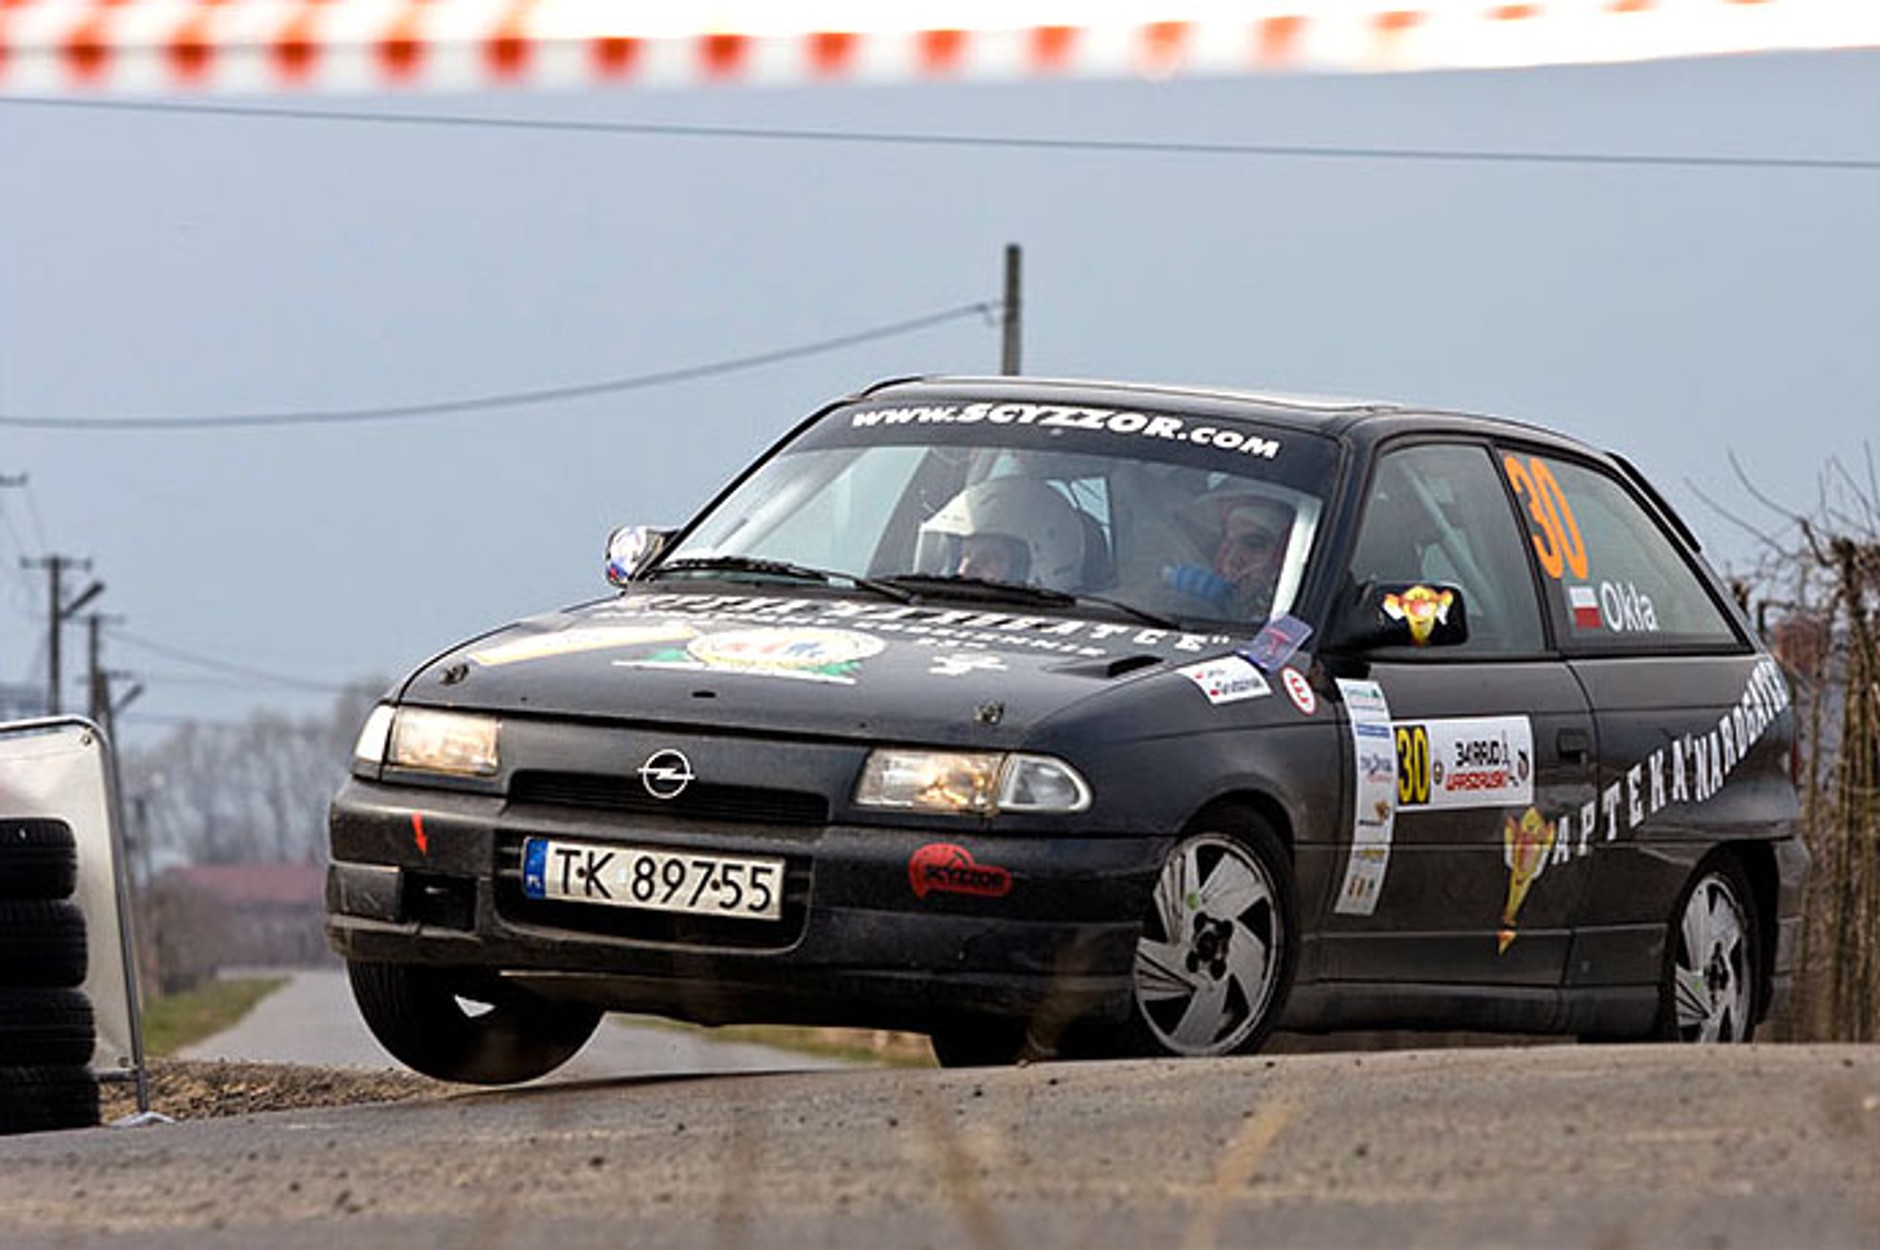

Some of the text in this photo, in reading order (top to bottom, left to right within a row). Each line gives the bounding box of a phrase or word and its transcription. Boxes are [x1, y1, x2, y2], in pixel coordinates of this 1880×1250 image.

[1503, 455, 1588, 579] 30
[1397, 727, 1430, 803] 30
[555, 849, 774, 912] TK 89755
